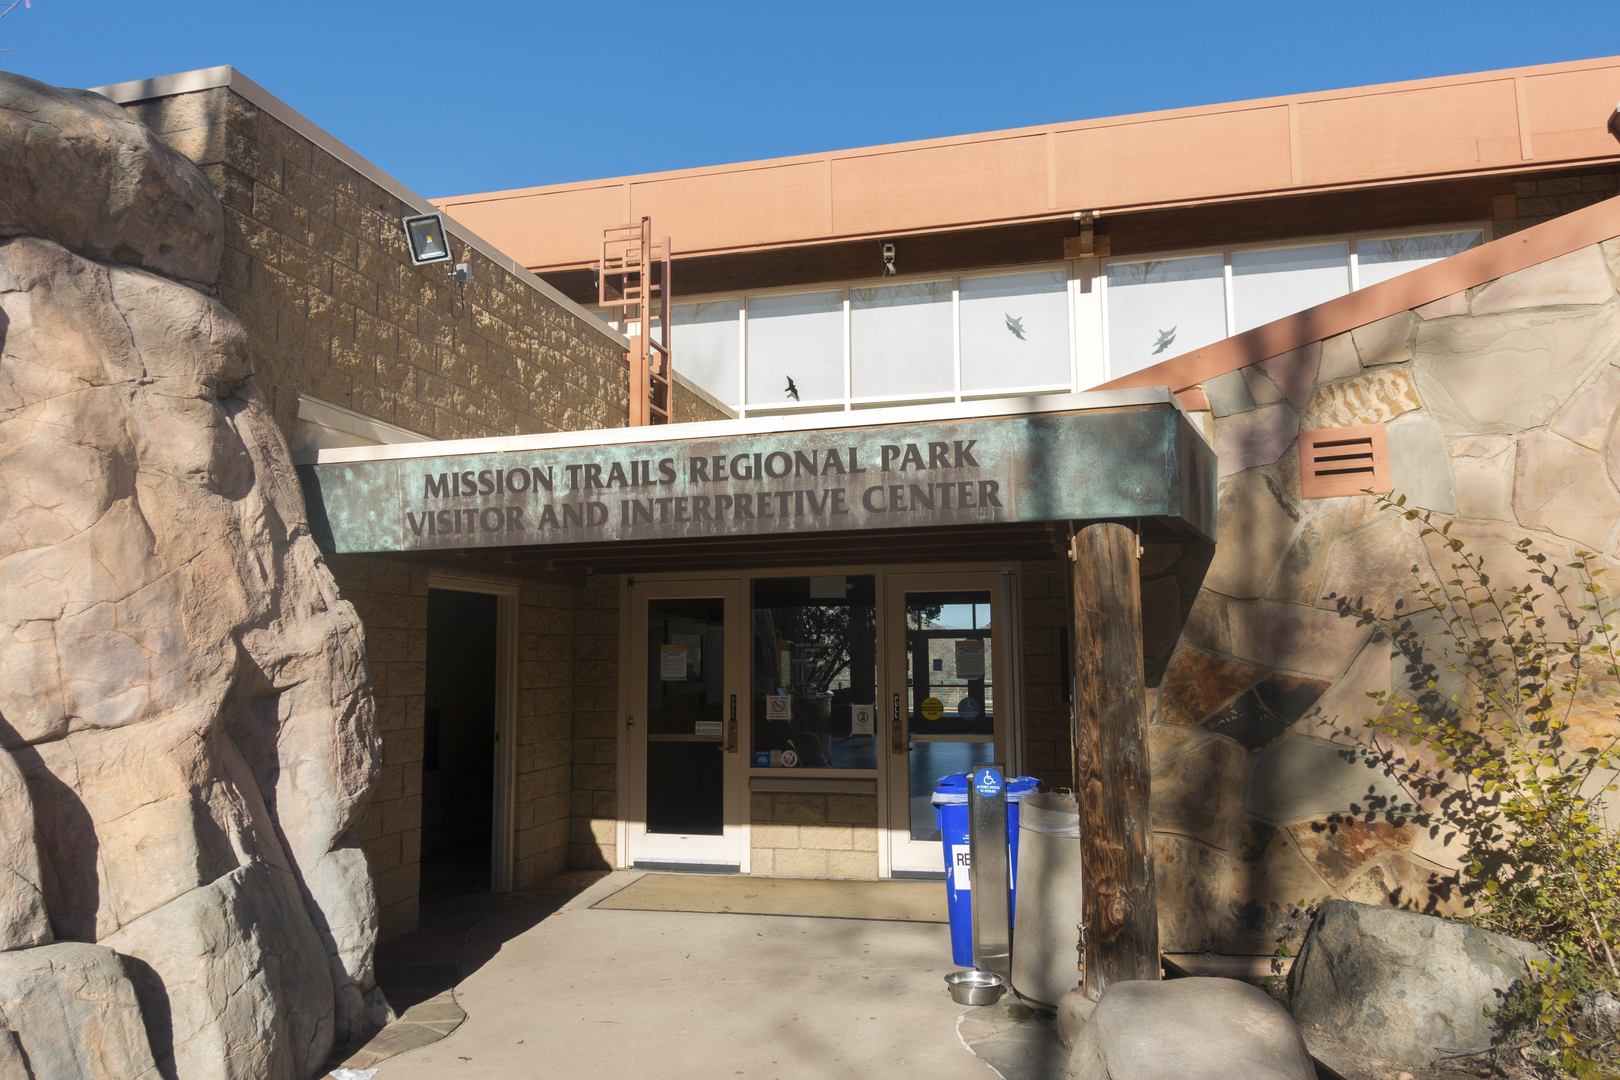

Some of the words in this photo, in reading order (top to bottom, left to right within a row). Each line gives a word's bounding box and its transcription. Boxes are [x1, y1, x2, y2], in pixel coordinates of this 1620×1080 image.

[423, 466, 554, 499] MISSION
[565, 457, 677, 490] TRAILS
[689, 447, 867, 482] REGIONAL
[880, 439, 980, 472] PARK
[406, 506, 526, 537] VISITOR
[537, 501, 609, 530] AND
[620, 488, 849, 526] INTERPRETIVE
[862, 480, 1003, 513] CENTER
[957, 853, 970, 866] RE
